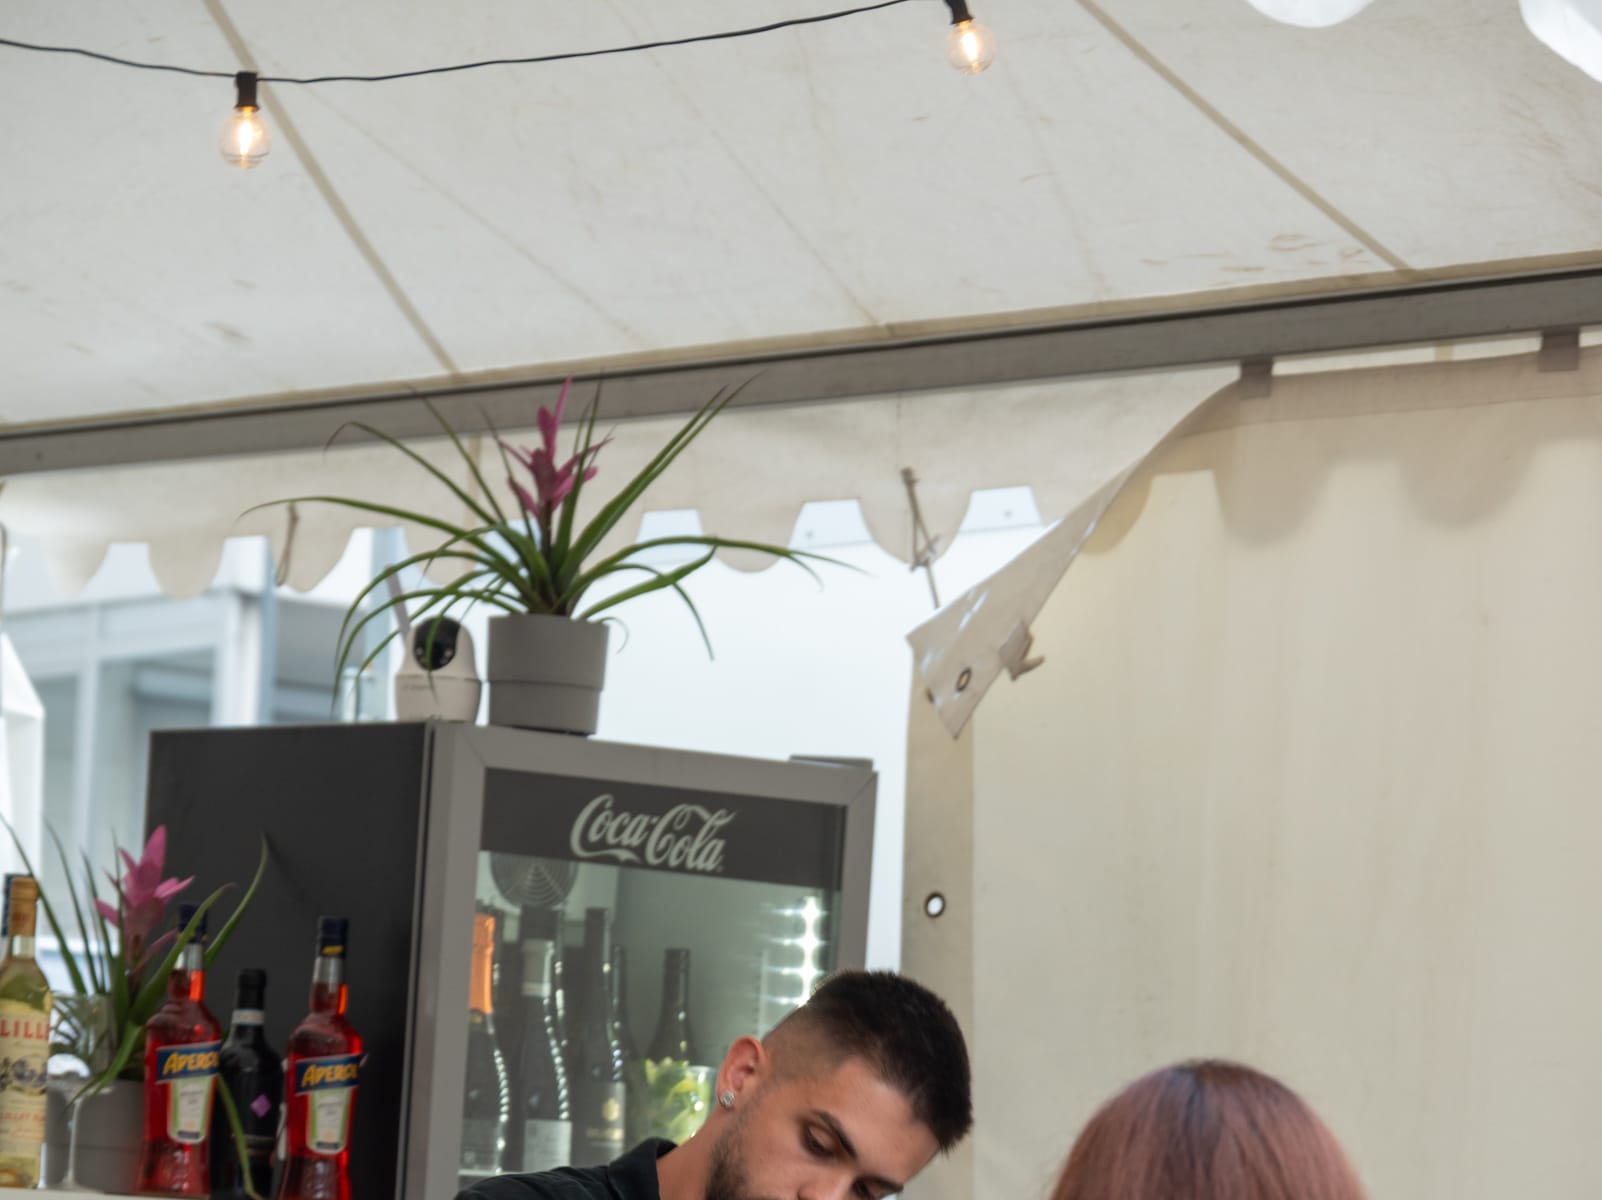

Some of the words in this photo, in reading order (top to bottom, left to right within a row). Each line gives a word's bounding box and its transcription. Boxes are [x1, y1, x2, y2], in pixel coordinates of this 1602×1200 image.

[570, 794, 737, 873] Coca-Cola
[162, 1051, 220, 1075] APERO
[301, 1063, 359, 1088] APERO
